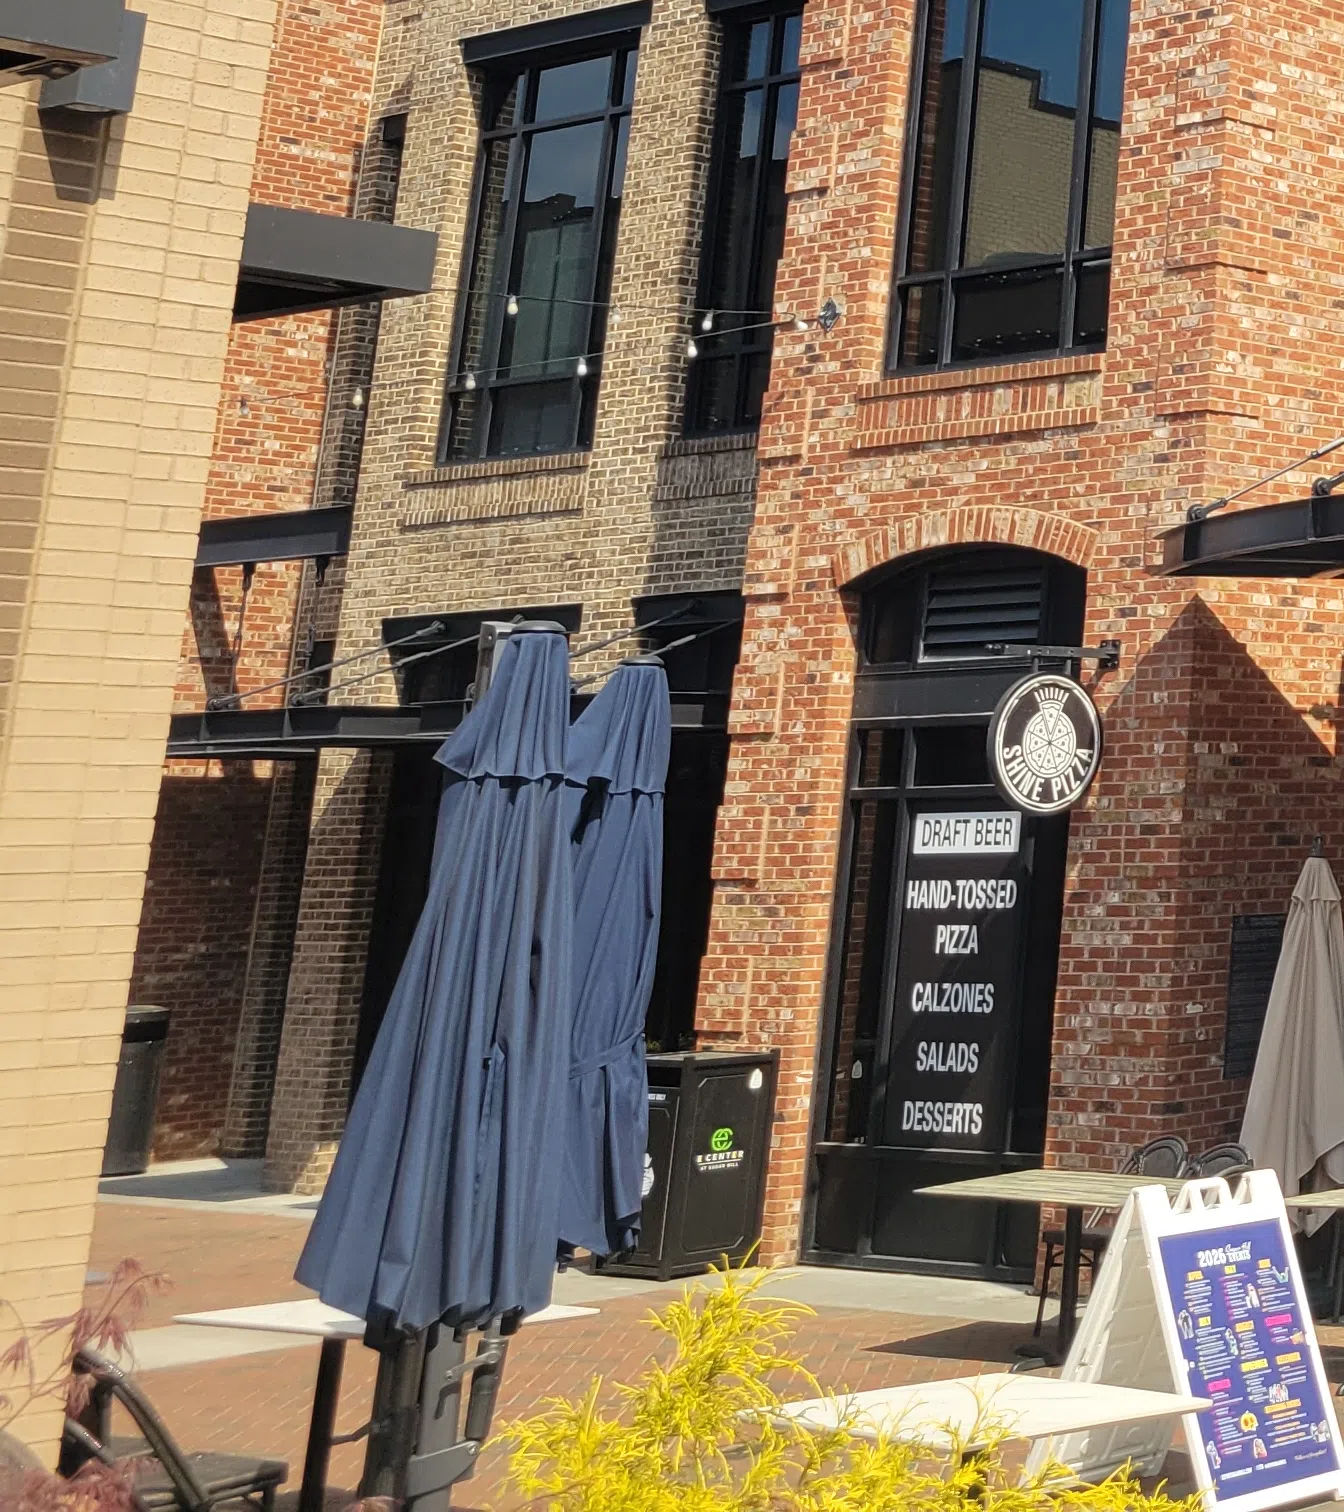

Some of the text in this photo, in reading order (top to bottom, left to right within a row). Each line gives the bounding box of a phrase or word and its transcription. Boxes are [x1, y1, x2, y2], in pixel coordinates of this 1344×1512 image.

[1003, 744, 1094, 802] SHINE PIZZA
[921, 817, 1013, 847] DRAFT BEER
[906, 879, 1017, 909] HAND-TOSSED
[935, 924, 979, 954] PIZZA
[911, 982, 995, 1013] CALZONES
[916, 1041, 979, 1073] SALADS
[902, 1100, 983, 1135] DESSERTS
[705, 1149, 745, 1162] CENTER
